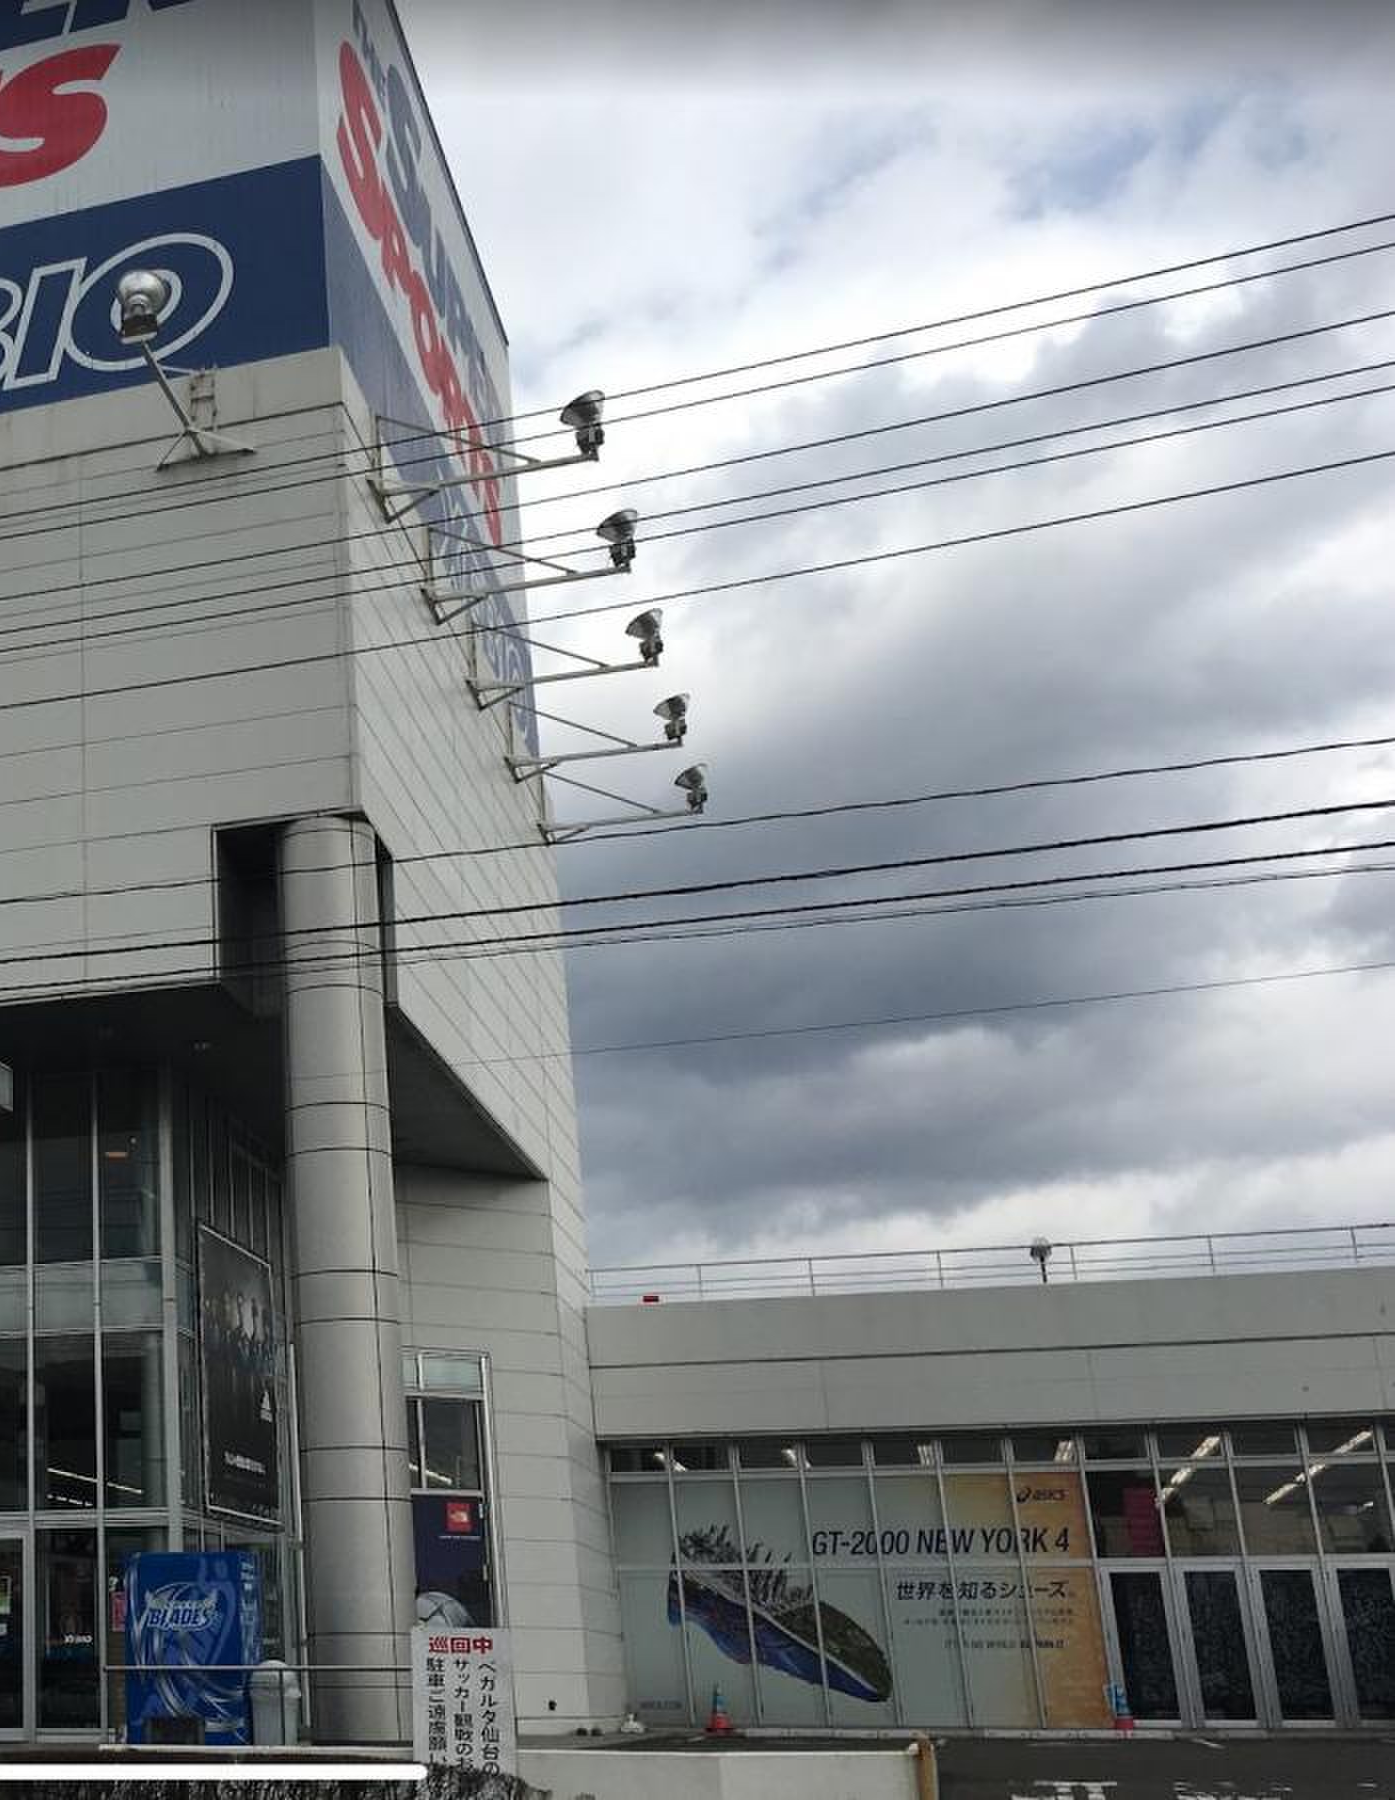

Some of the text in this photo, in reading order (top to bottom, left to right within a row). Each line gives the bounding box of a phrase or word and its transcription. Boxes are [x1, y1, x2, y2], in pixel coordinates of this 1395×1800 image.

[811, 1527, 1070, 1557] GT-2000 NEW YORK 4
[428, 1636, 493, 1655] 巡回中
